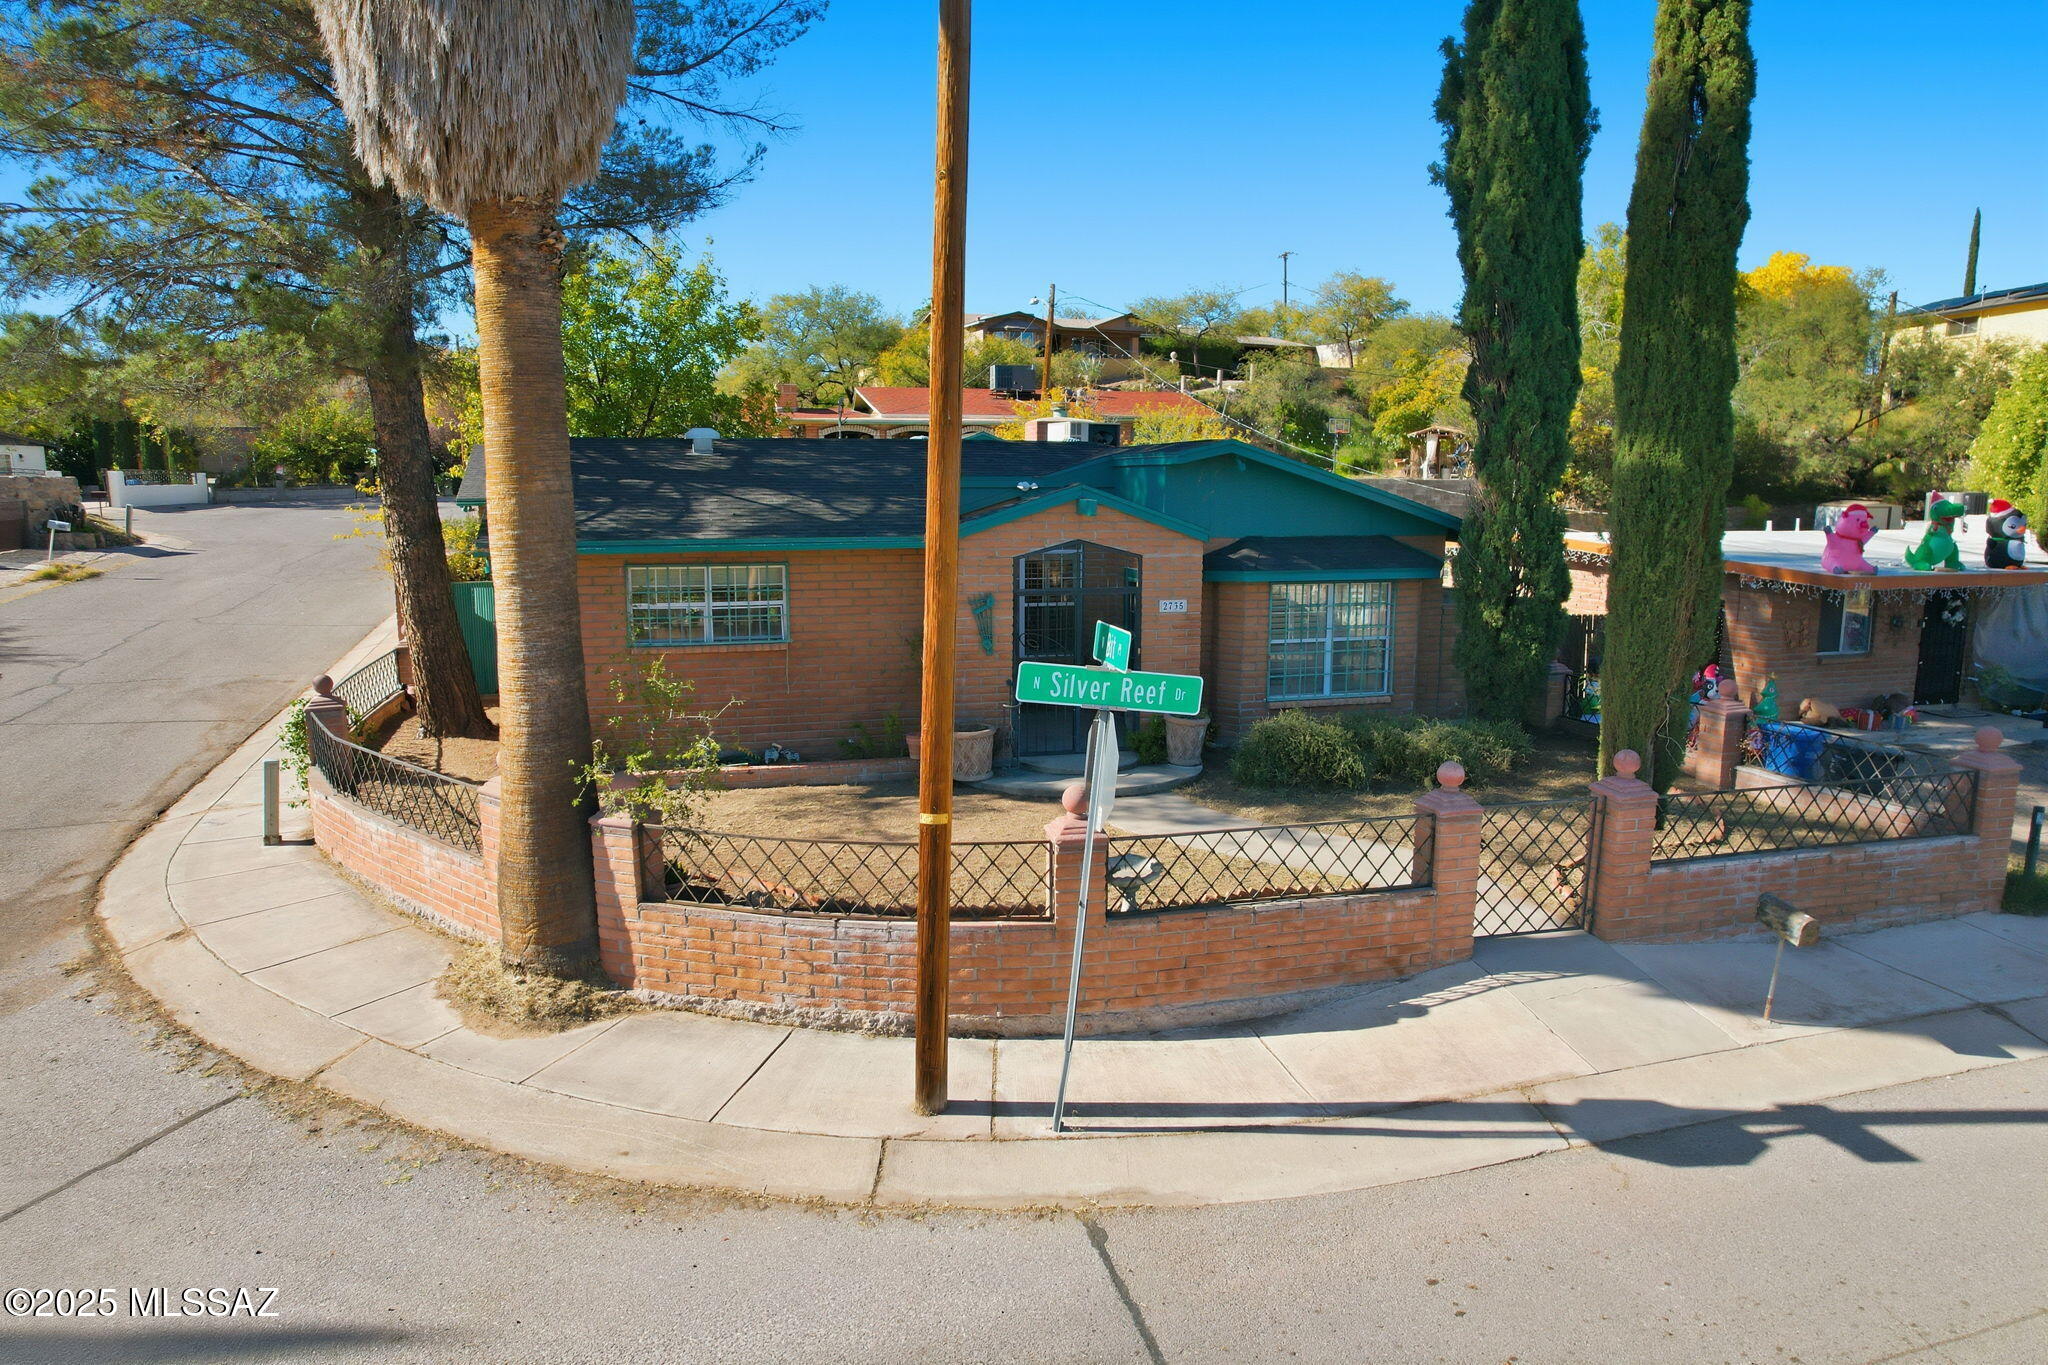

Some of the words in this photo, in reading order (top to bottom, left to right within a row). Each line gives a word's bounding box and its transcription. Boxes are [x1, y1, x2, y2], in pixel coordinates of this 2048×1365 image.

[1163, 601, 1184, 611] 2735
[1033, 676, 1041, 690] N
[1049, 671, 1111, 701] Silver
[1120, 677, 1167, 705] Reef
[1174, 687, 1187, 701] Dr
